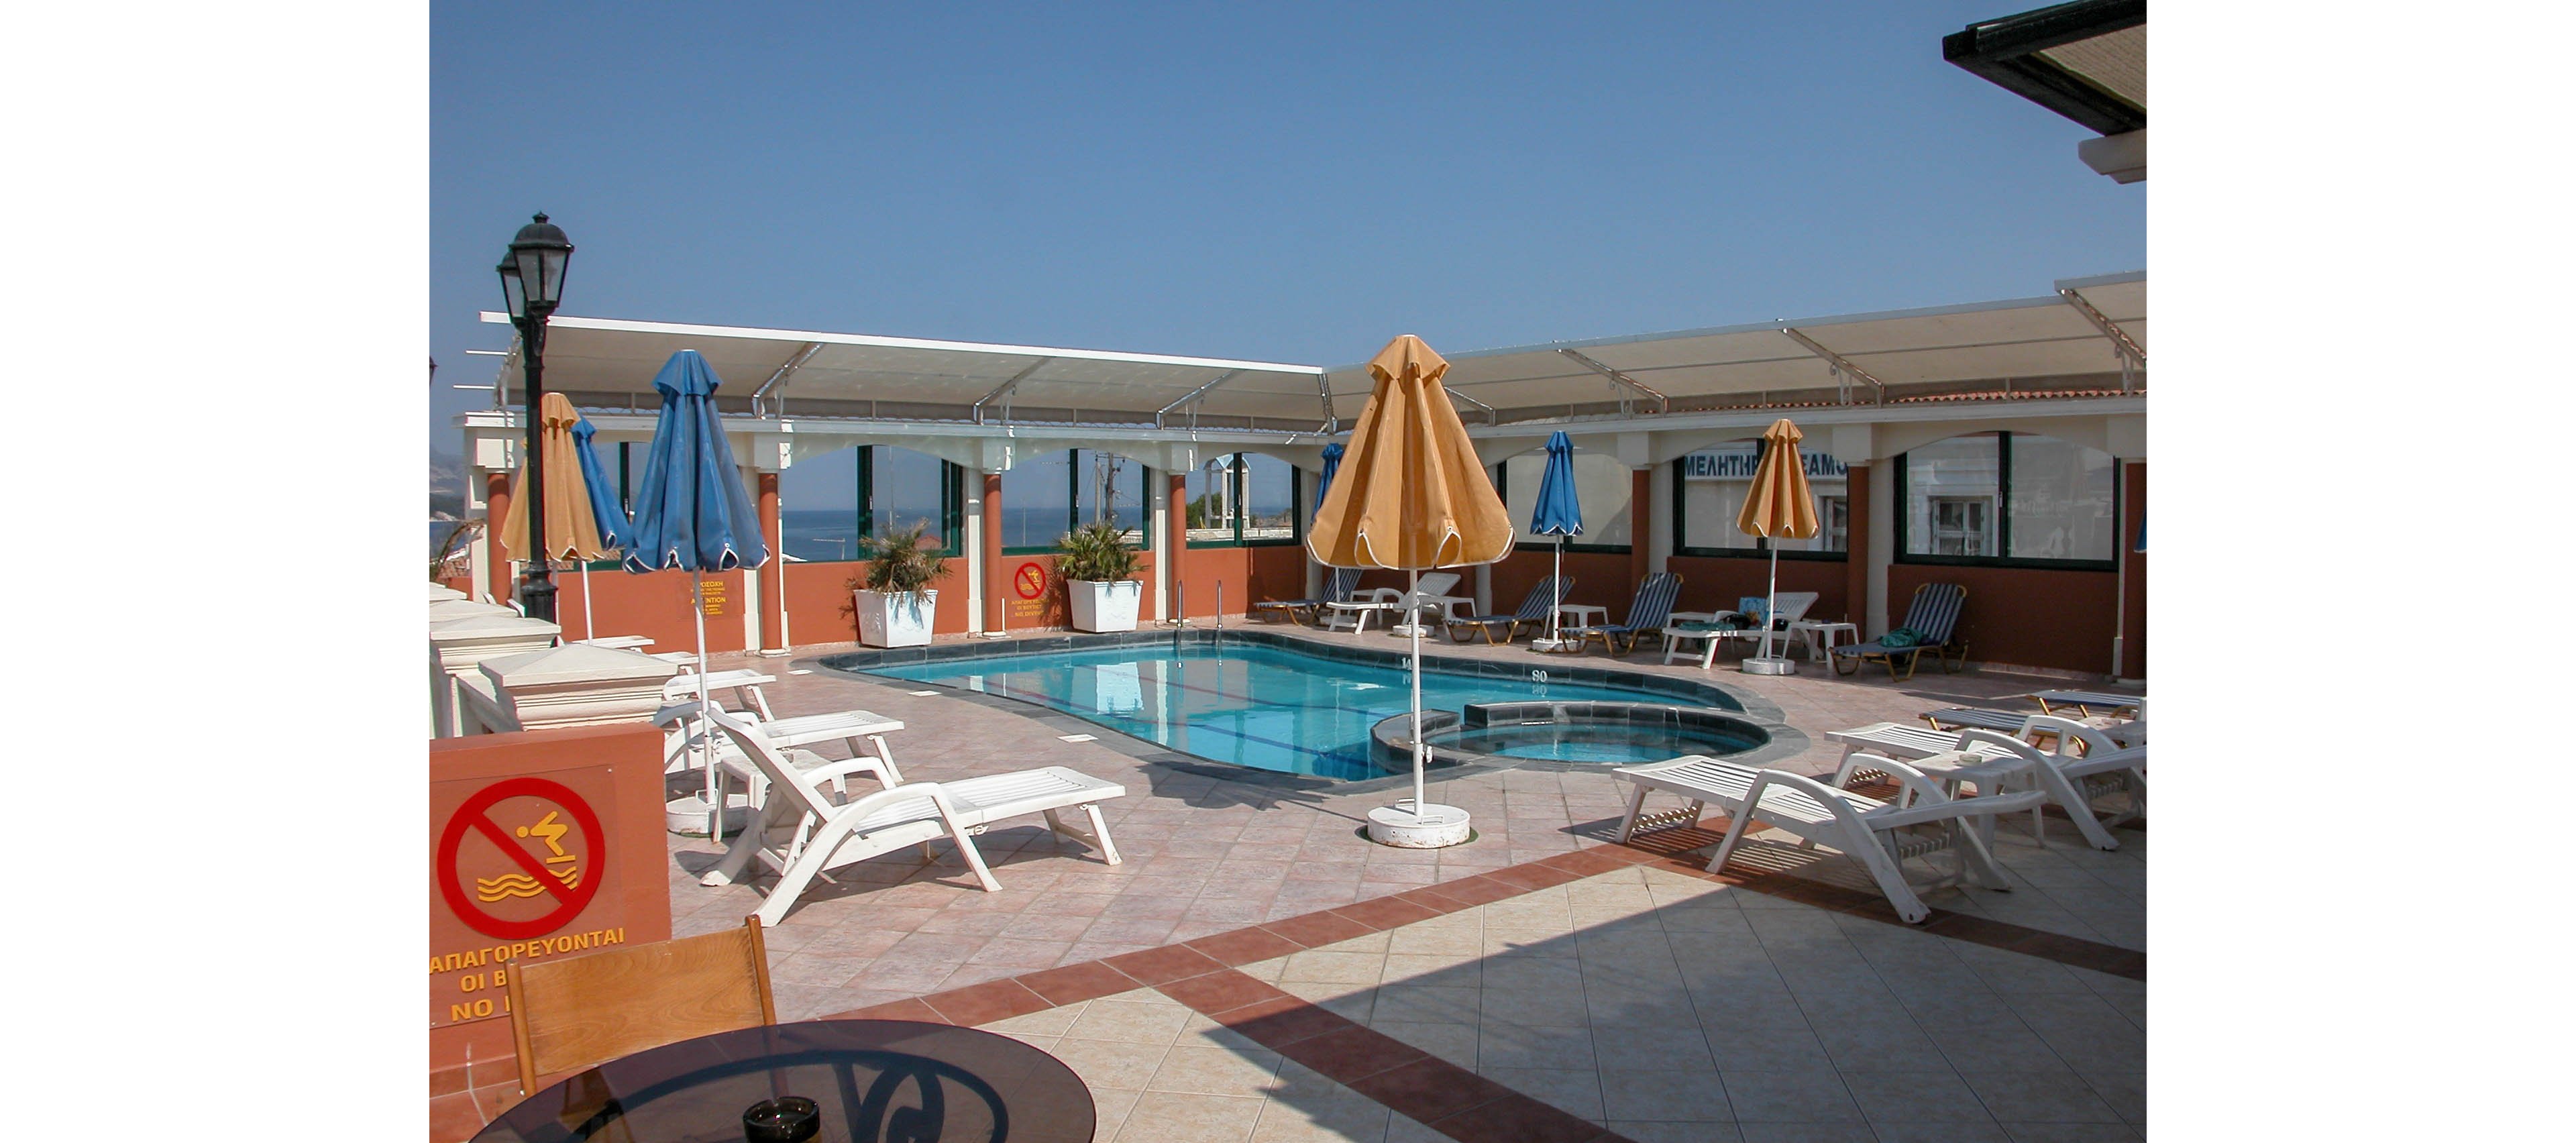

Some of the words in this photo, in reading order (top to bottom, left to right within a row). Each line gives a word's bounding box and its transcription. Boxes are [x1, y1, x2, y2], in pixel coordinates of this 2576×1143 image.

[1532, 670, 1547, 682] 80
[429, 927, 625, 973] ΑΠΑΓΟΡΕΥΟΝΤΑΙ
[460, 973, 485, 993] ΟΙ
[451, 998, 494, 1022] NO
